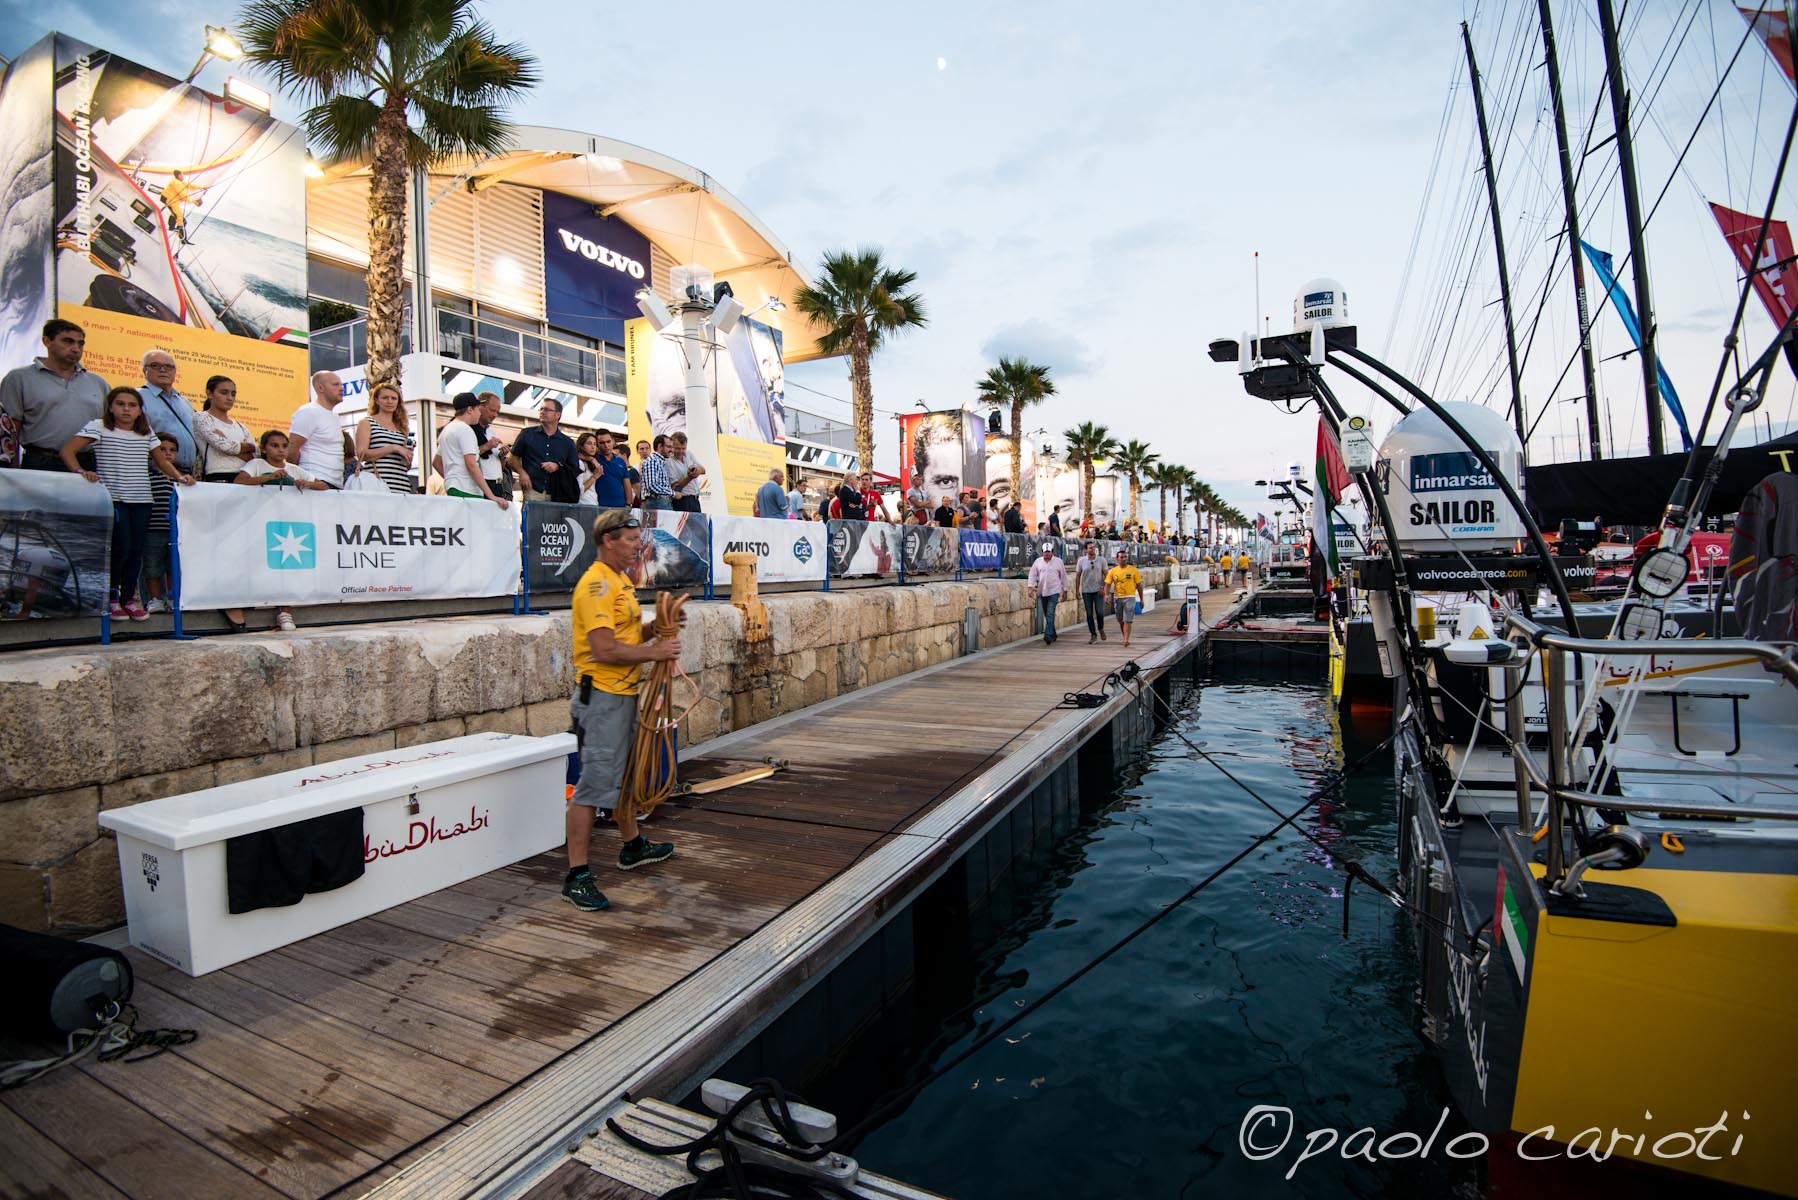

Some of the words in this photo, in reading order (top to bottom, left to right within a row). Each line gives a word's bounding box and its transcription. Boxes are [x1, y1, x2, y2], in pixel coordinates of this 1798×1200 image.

[76, 116, 91, 172] OCEAN
[76, 174, 90, 225] DHABI
[558, 228, 645, 279] VOLVO
[1304, 308, 1332, 320] SAILOR
[127, 329, 173, 342] nationalities
[84, 351, 104, 360] This
[1415, 474, 1496, 490] inmarsat
[1410, 500, 1495, 526] SAILOR
[336, 524, 466, 546] MAERSK
[542, 522, 568, 534] VOLVO
[540, 535, 570, 546] OCEAN
[540, 546, 562, 557] RACE
[723, 541, 770, 557] MUSTO
[965, 542, 998, 557] VOLVO
[338, 552, 396, 568] LINE
[1417, 568, 1528, 580] volvooceanrace.com
[342, 586, 368, 594] Official
